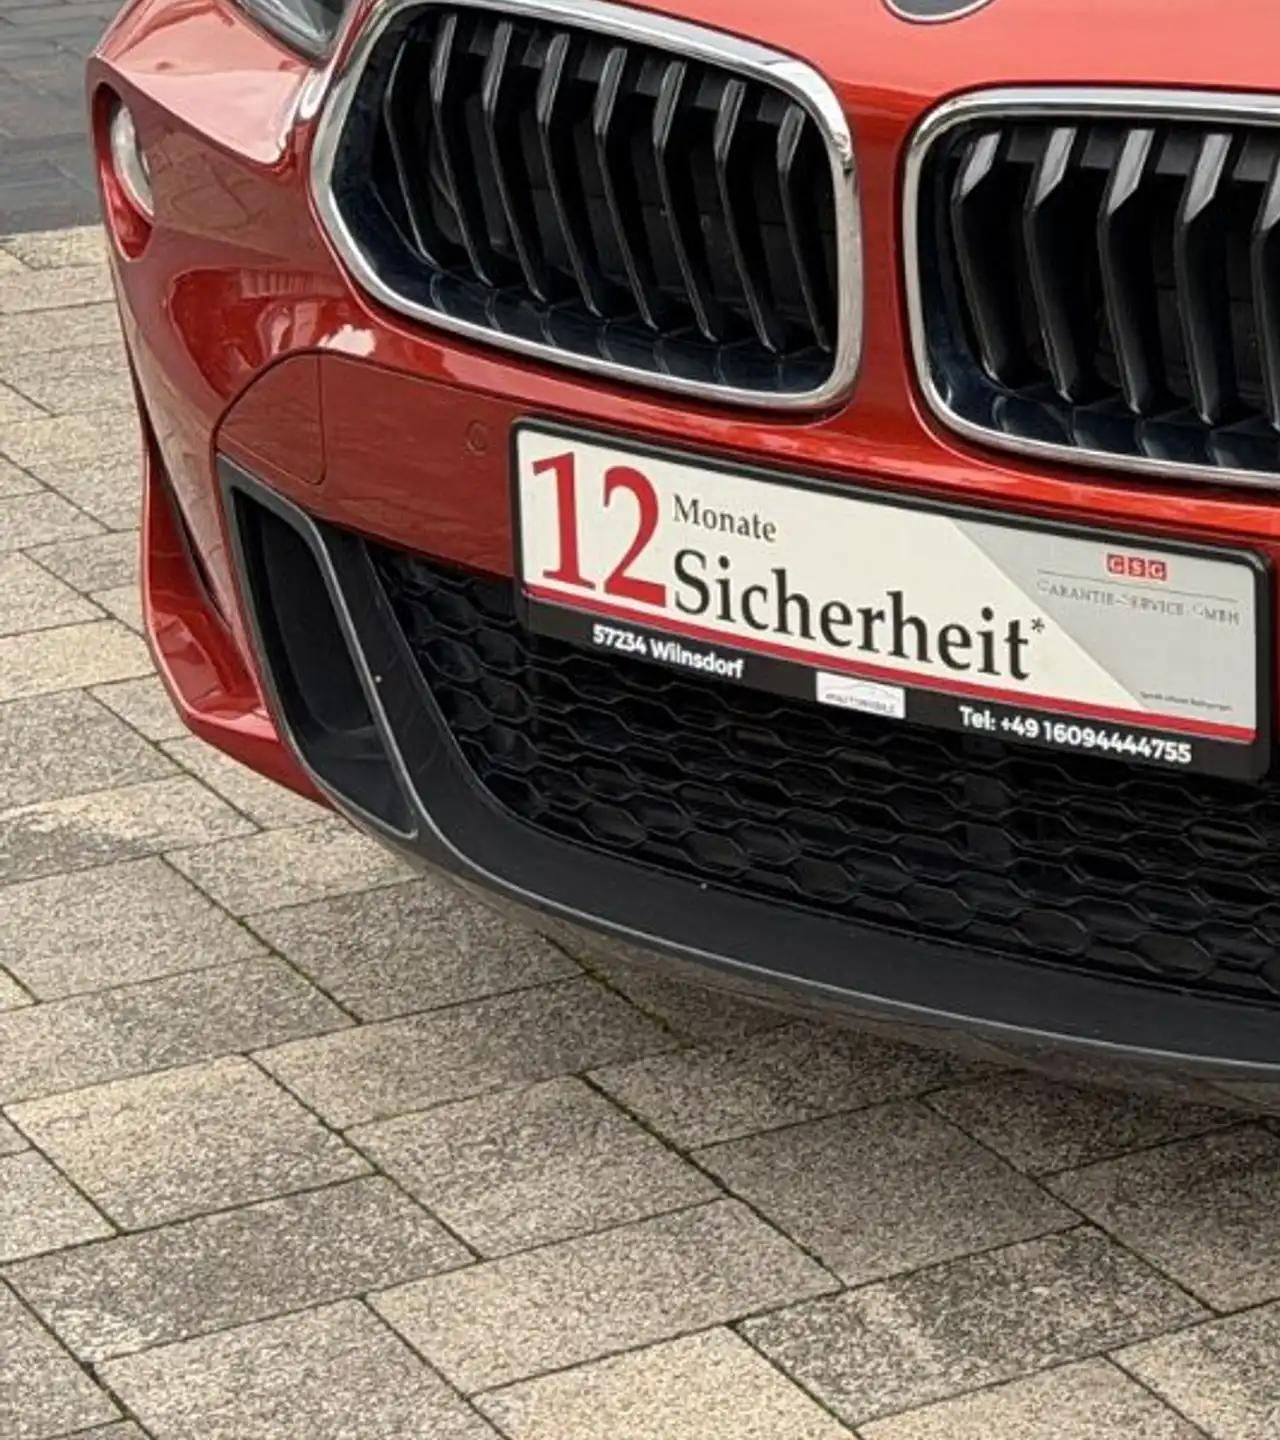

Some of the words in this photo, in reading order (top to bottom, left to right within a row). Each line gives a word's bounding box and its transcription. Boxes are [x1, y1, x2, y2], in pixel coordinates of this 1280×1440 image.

[532, 451, 667, 609] 12
[672, 492, 777, 543] Monate
[592, 623, 648, 656] 57234
[650, 638, 744, 679] Wilnsdorf
[959, 705, 995, 732] Tel:
[1000, 715, 1039, 739] +49
[1043, 721, 1192, 764] 16094444755
